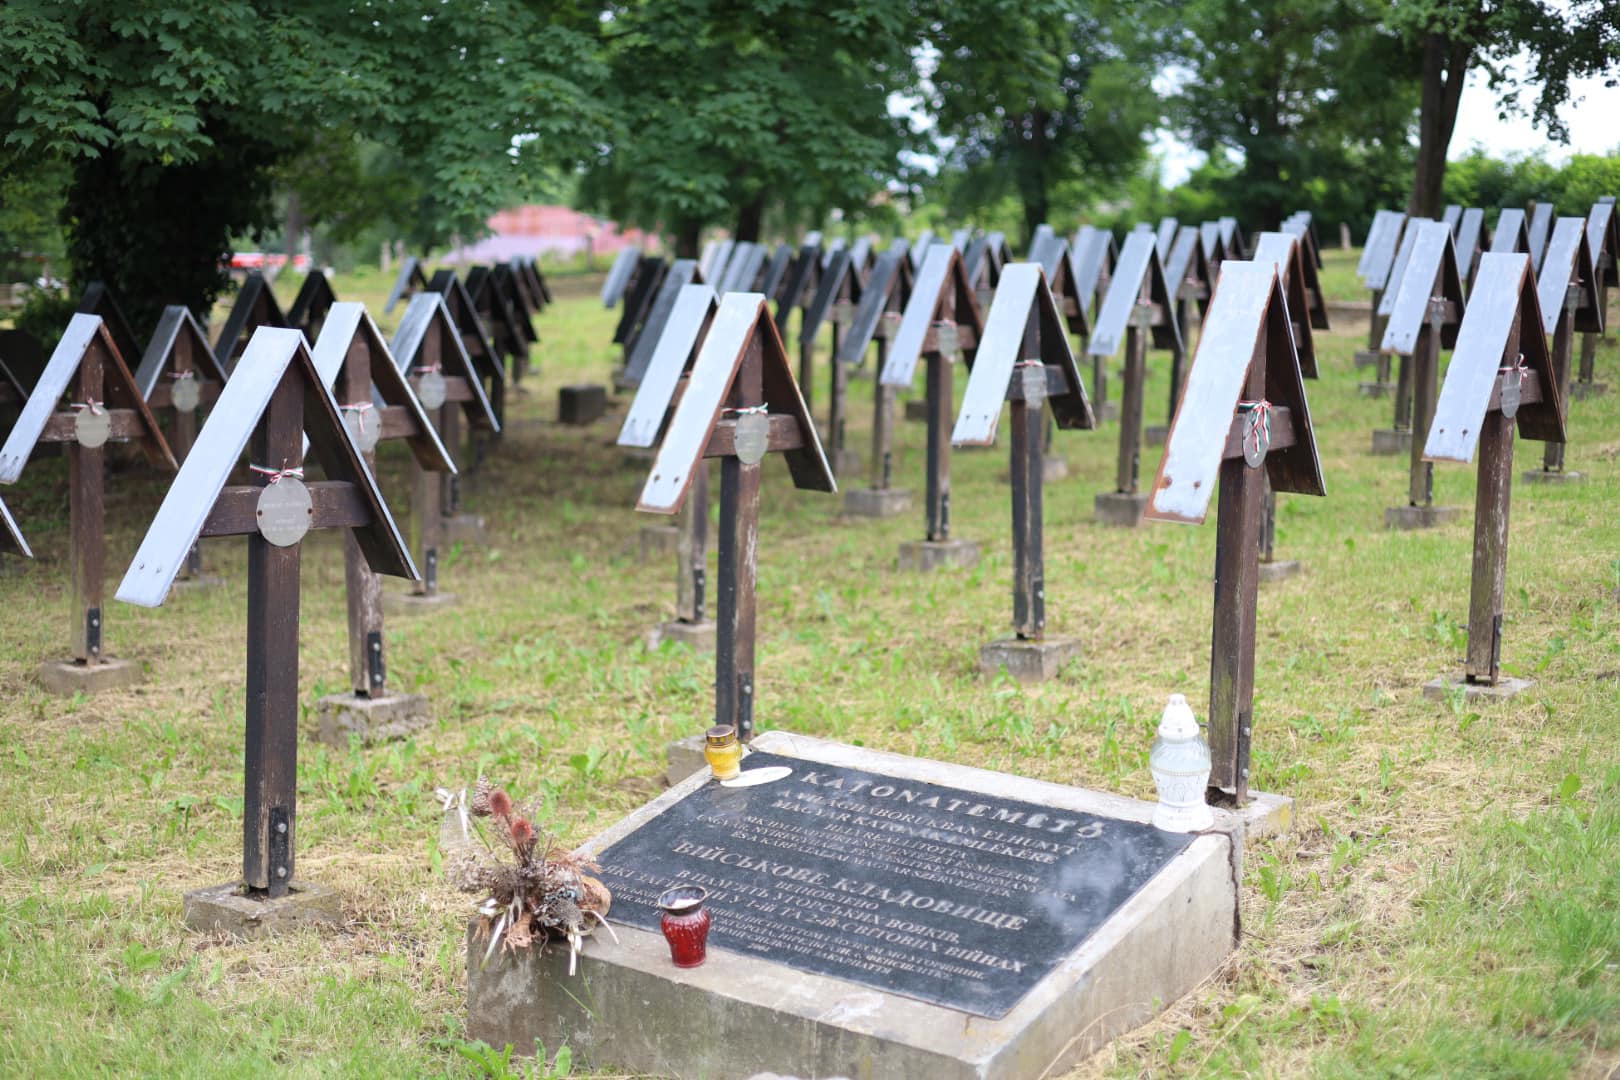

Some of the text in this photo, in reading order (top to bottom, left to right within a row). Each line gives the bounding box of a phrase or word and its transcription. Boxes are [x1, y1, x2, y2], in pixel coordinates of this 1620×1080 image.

[769, 799, 854, 821] MAGYAR
[978, 829, 1080, 855] ELHUNYT
[669, 838, 1033, 933] ВІЙСЬКОВЕ КЛАДОВИЩЕ
[770, 892, 886, 925] УГОРСЬКИХ
[775, 906, 808, 919] ТА
[941, 943, 1032, 973] ВІЙНАХ
